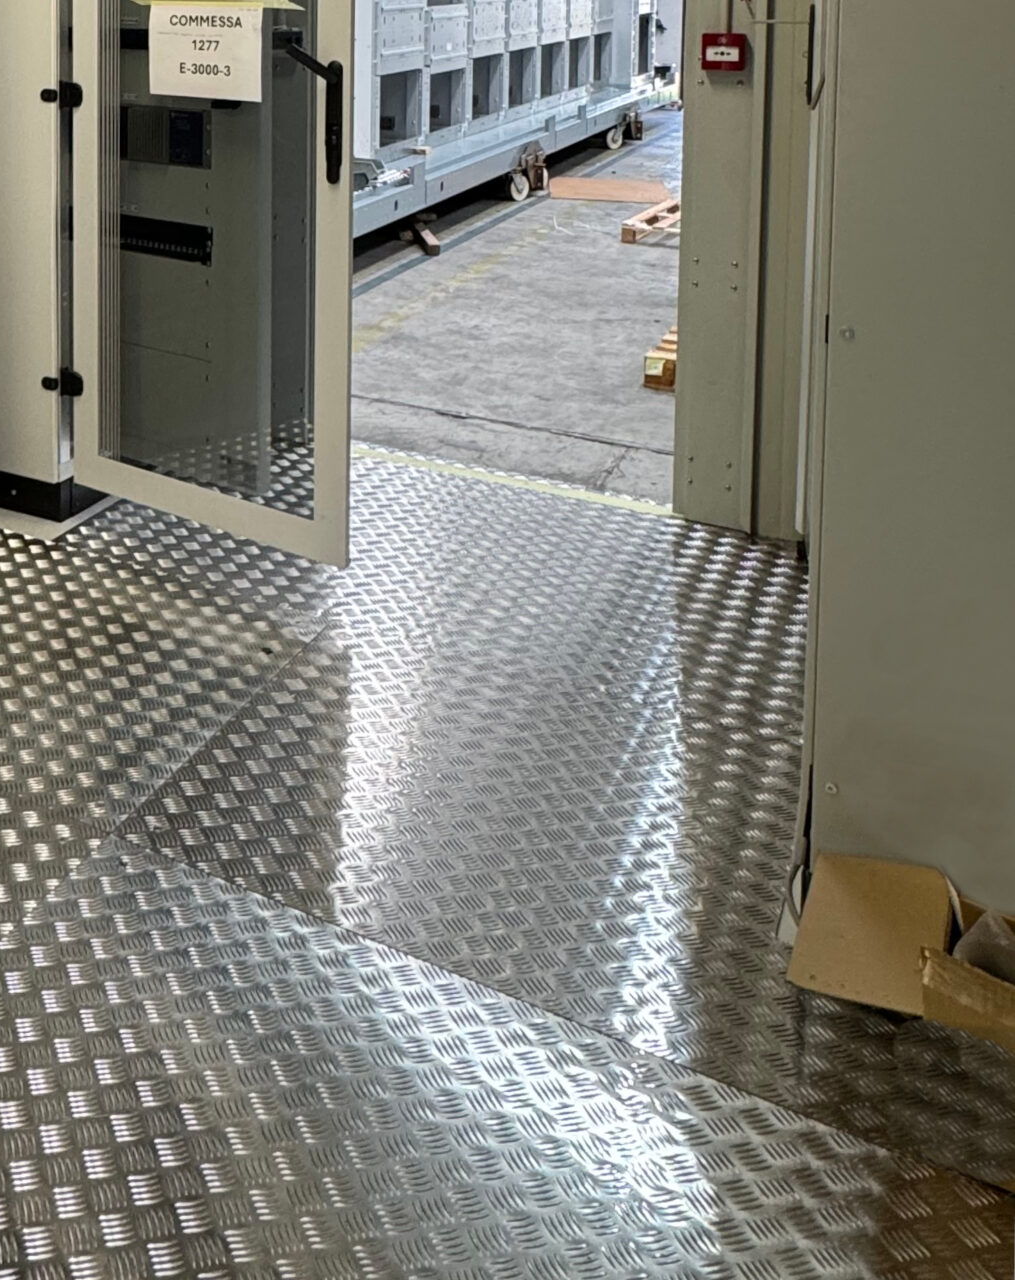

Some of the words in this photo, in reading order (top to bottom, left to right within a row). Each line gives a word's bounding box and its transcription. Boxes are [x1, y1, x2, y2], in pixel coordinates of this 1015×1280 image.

[169, 14, 243, 28] COMMESSA
[191, 39, 220, 52] 1277
[179, 62, 231, 77] E-3000-3
